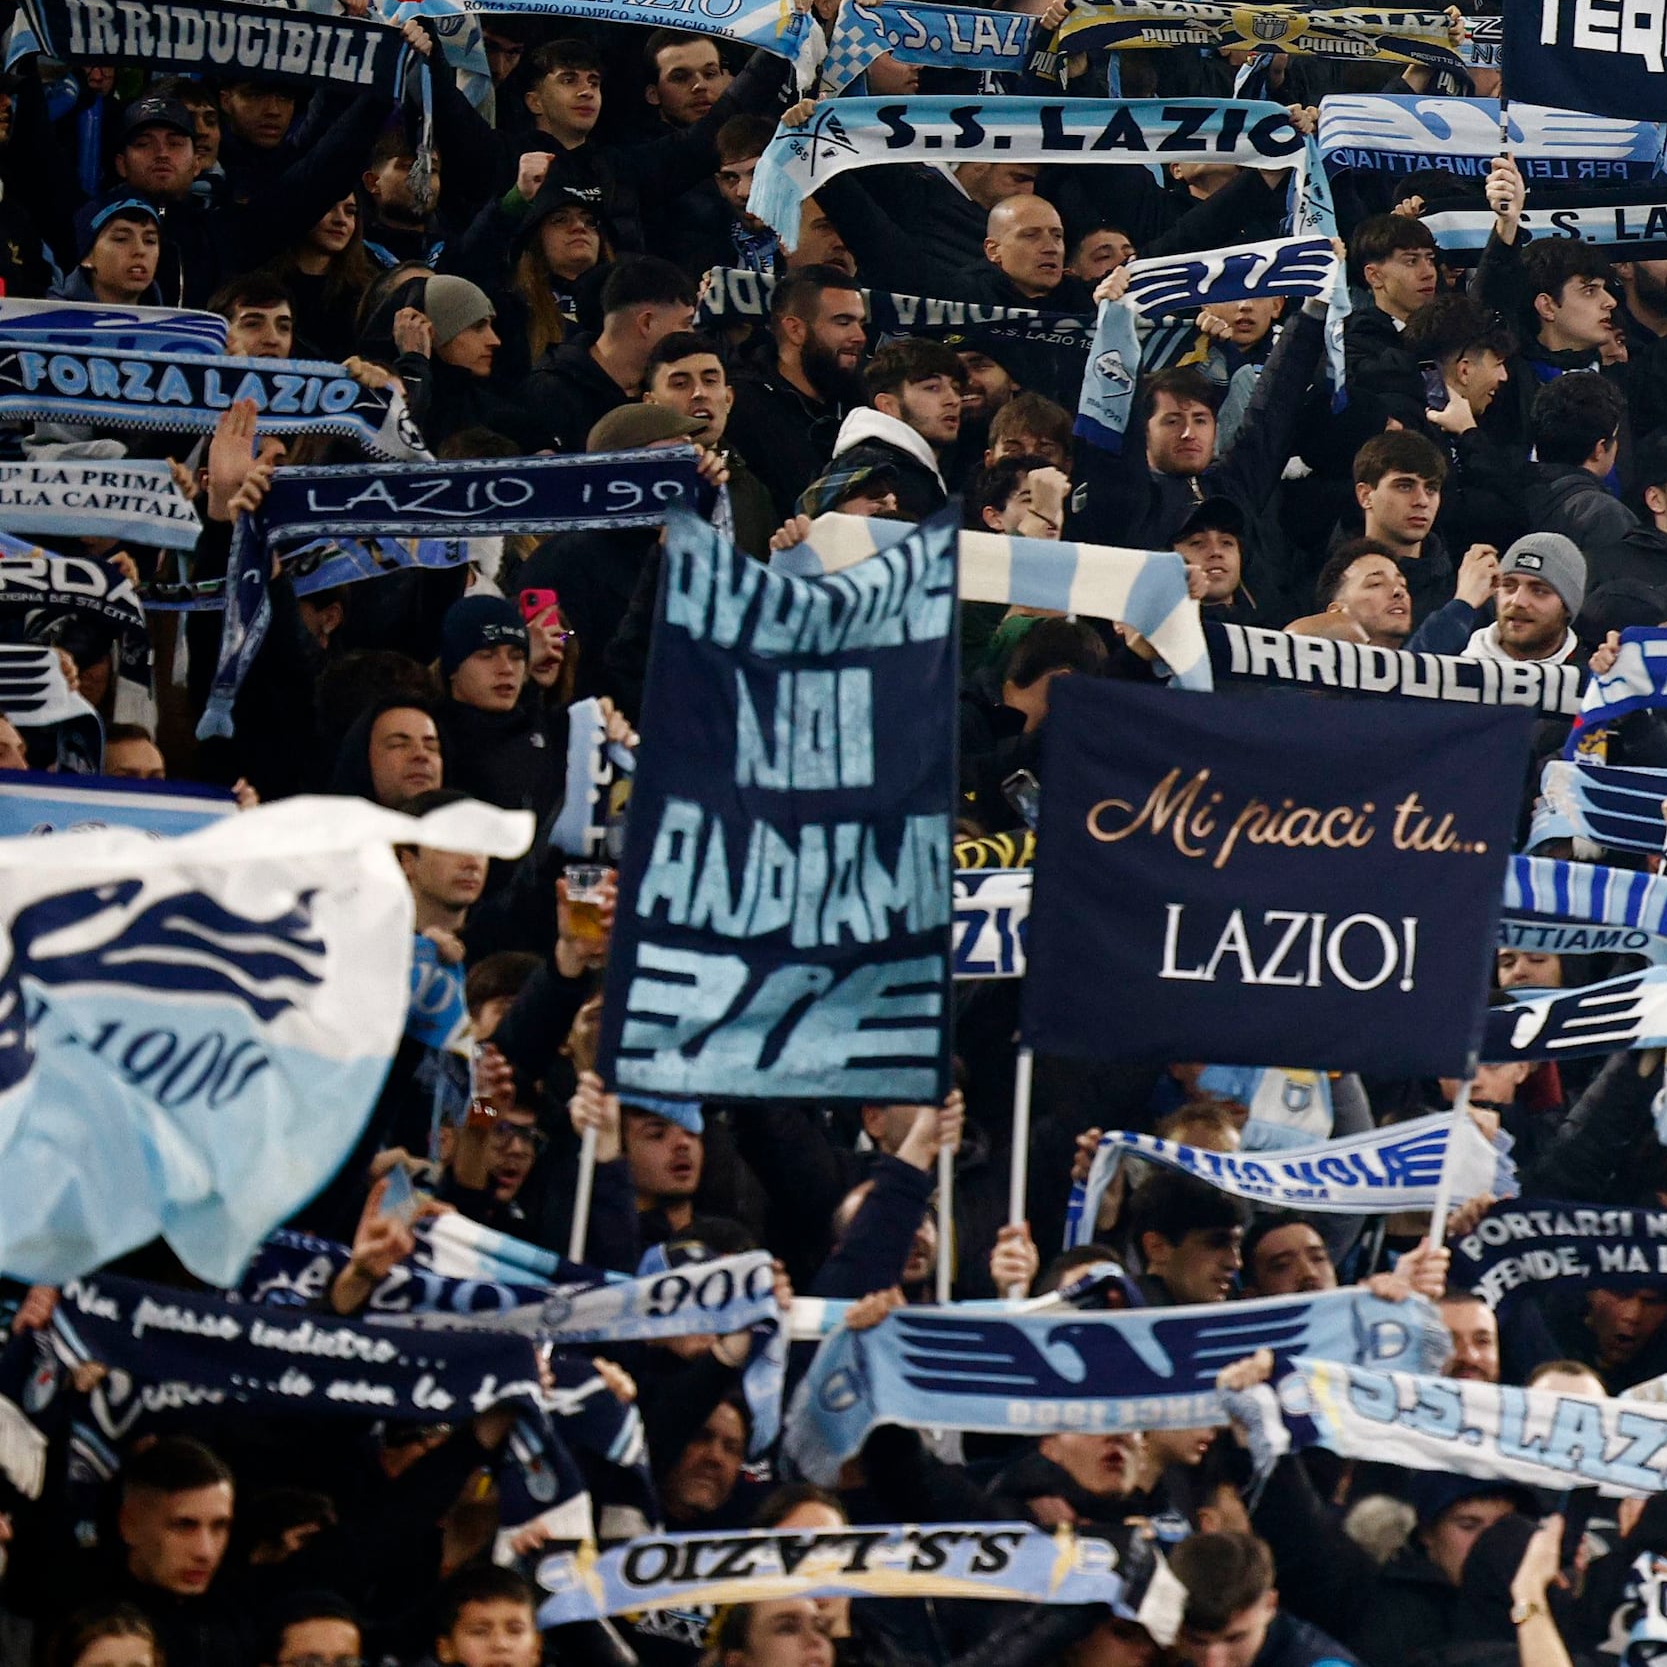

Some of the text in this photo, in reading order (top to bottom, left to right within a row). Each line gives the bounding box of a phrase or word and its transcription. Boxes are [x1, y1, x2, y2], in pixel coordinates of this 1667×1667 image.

[463, 0, 631, 21] ROMA STADIO OLIMPICO
[878, 103, 1305, 157] S.S. LAZIO
[1025, 327, 1077, 347] LAZIO
[19, 354, 358, 416] FORZA LAZIO
[31, 468, 180, 497] LA PRIMA
[305, 479, 538, 514] LAZIO
[1087, 767, 1489, 869] Mi piaci tu...
[1158, 902, 1419, 994] LAZIO!
[1599, 1247, 1651, 1274] MA
